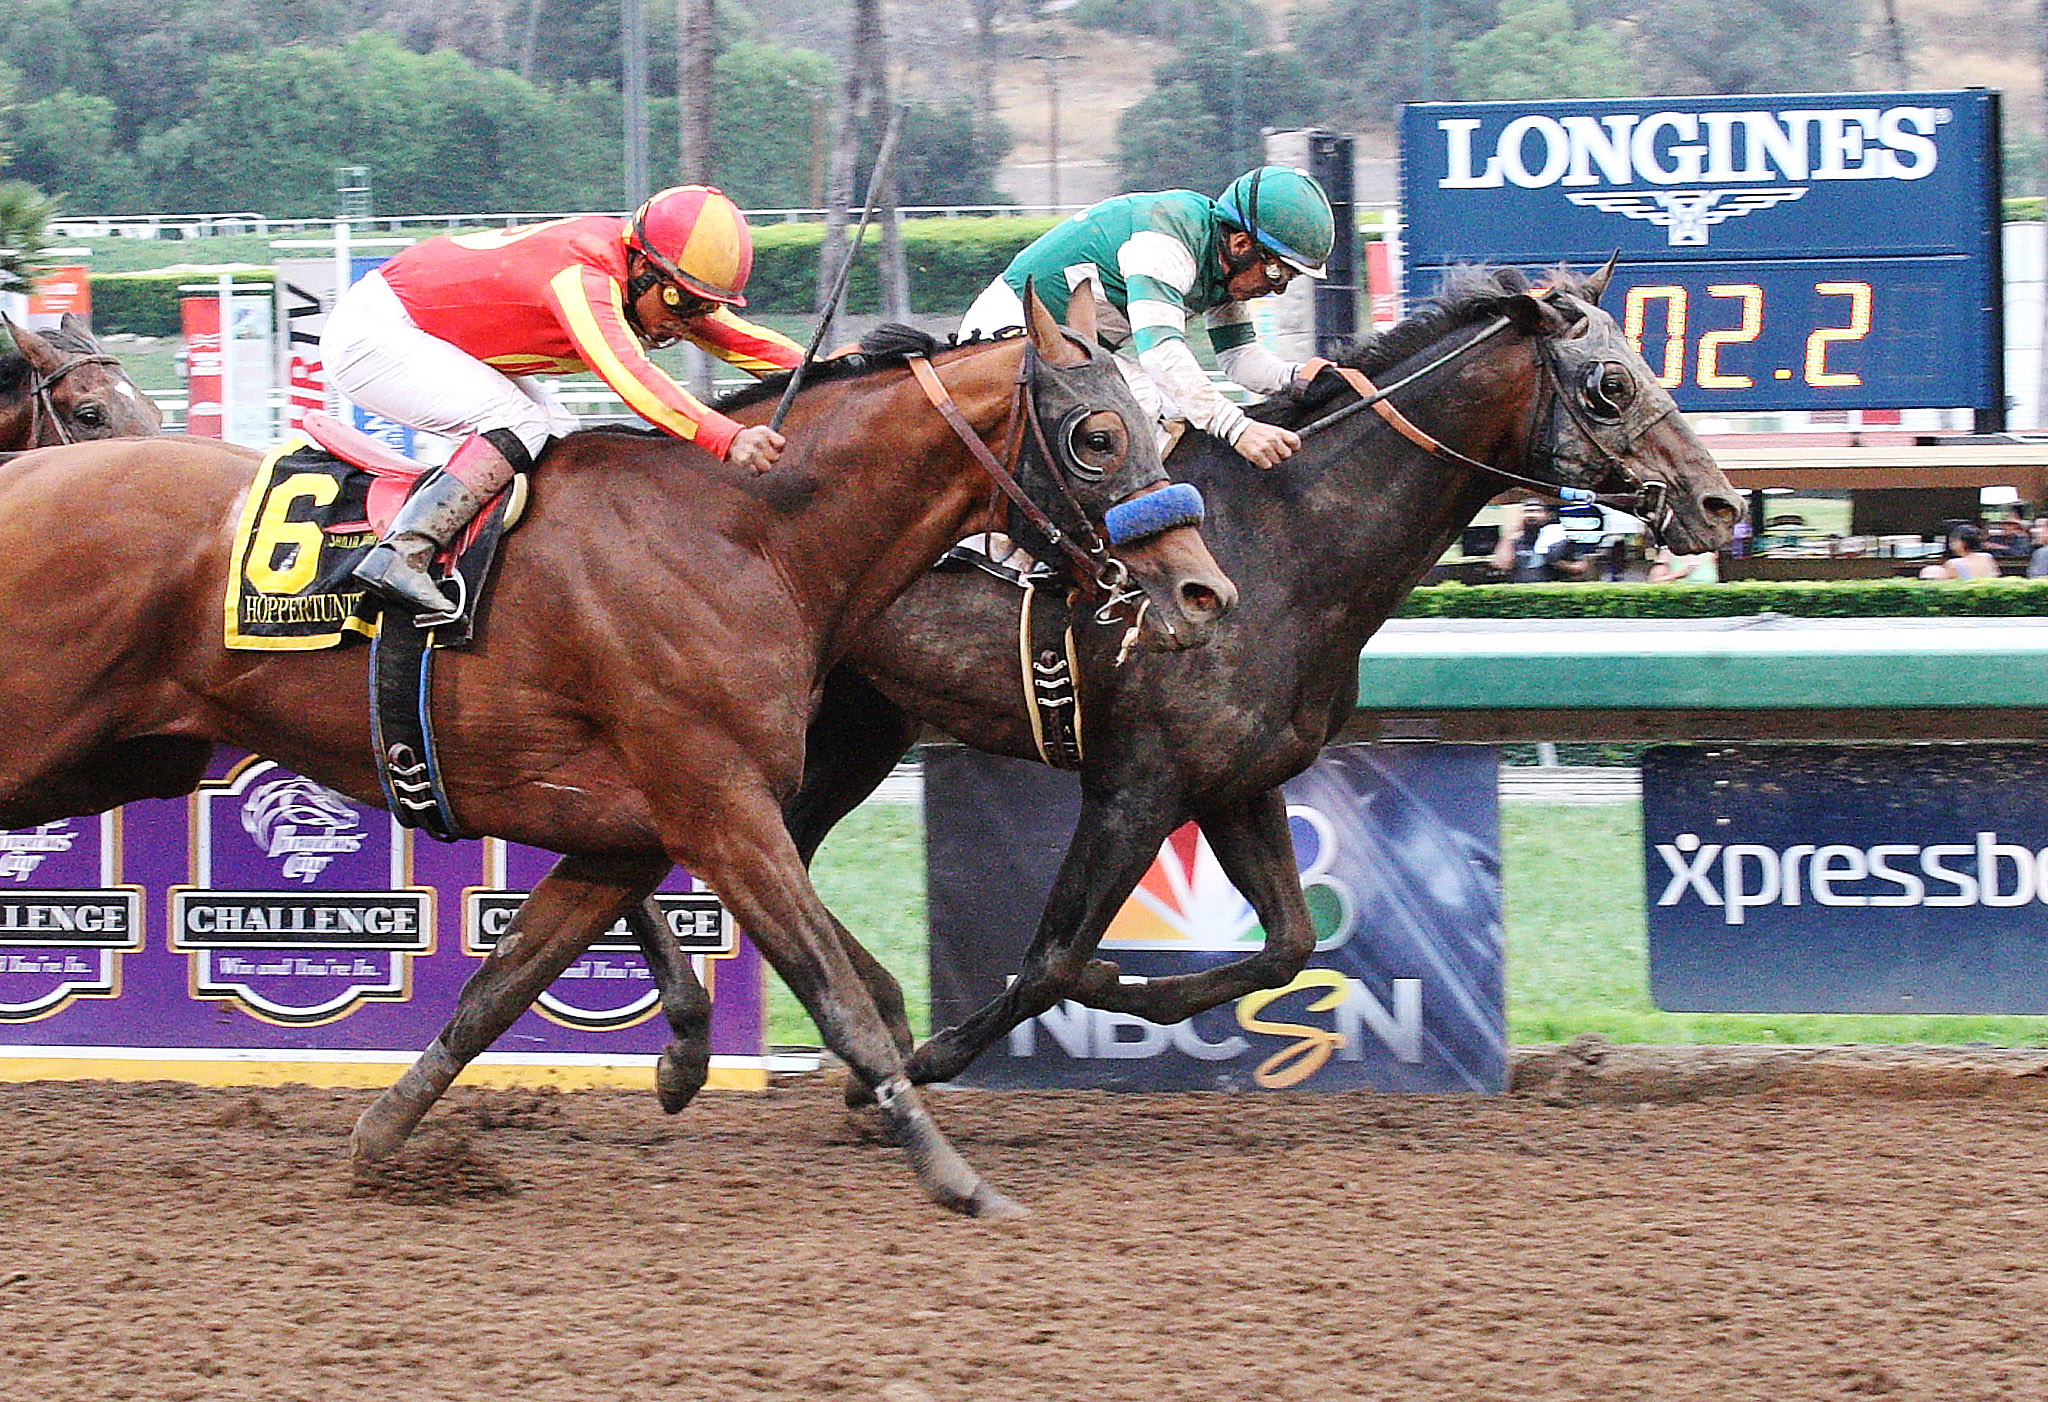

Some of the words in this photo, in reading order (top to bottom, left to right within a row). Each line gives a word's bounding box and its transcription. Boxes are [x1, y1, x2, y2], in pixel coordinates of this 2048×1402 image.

[1438, 106, 1937, 189] LONGINES
[245, 472, 341, 595] 6
[186, 905, 417, 934] CHALLENGE
[1654, 831, 2048, 925] xpressb
